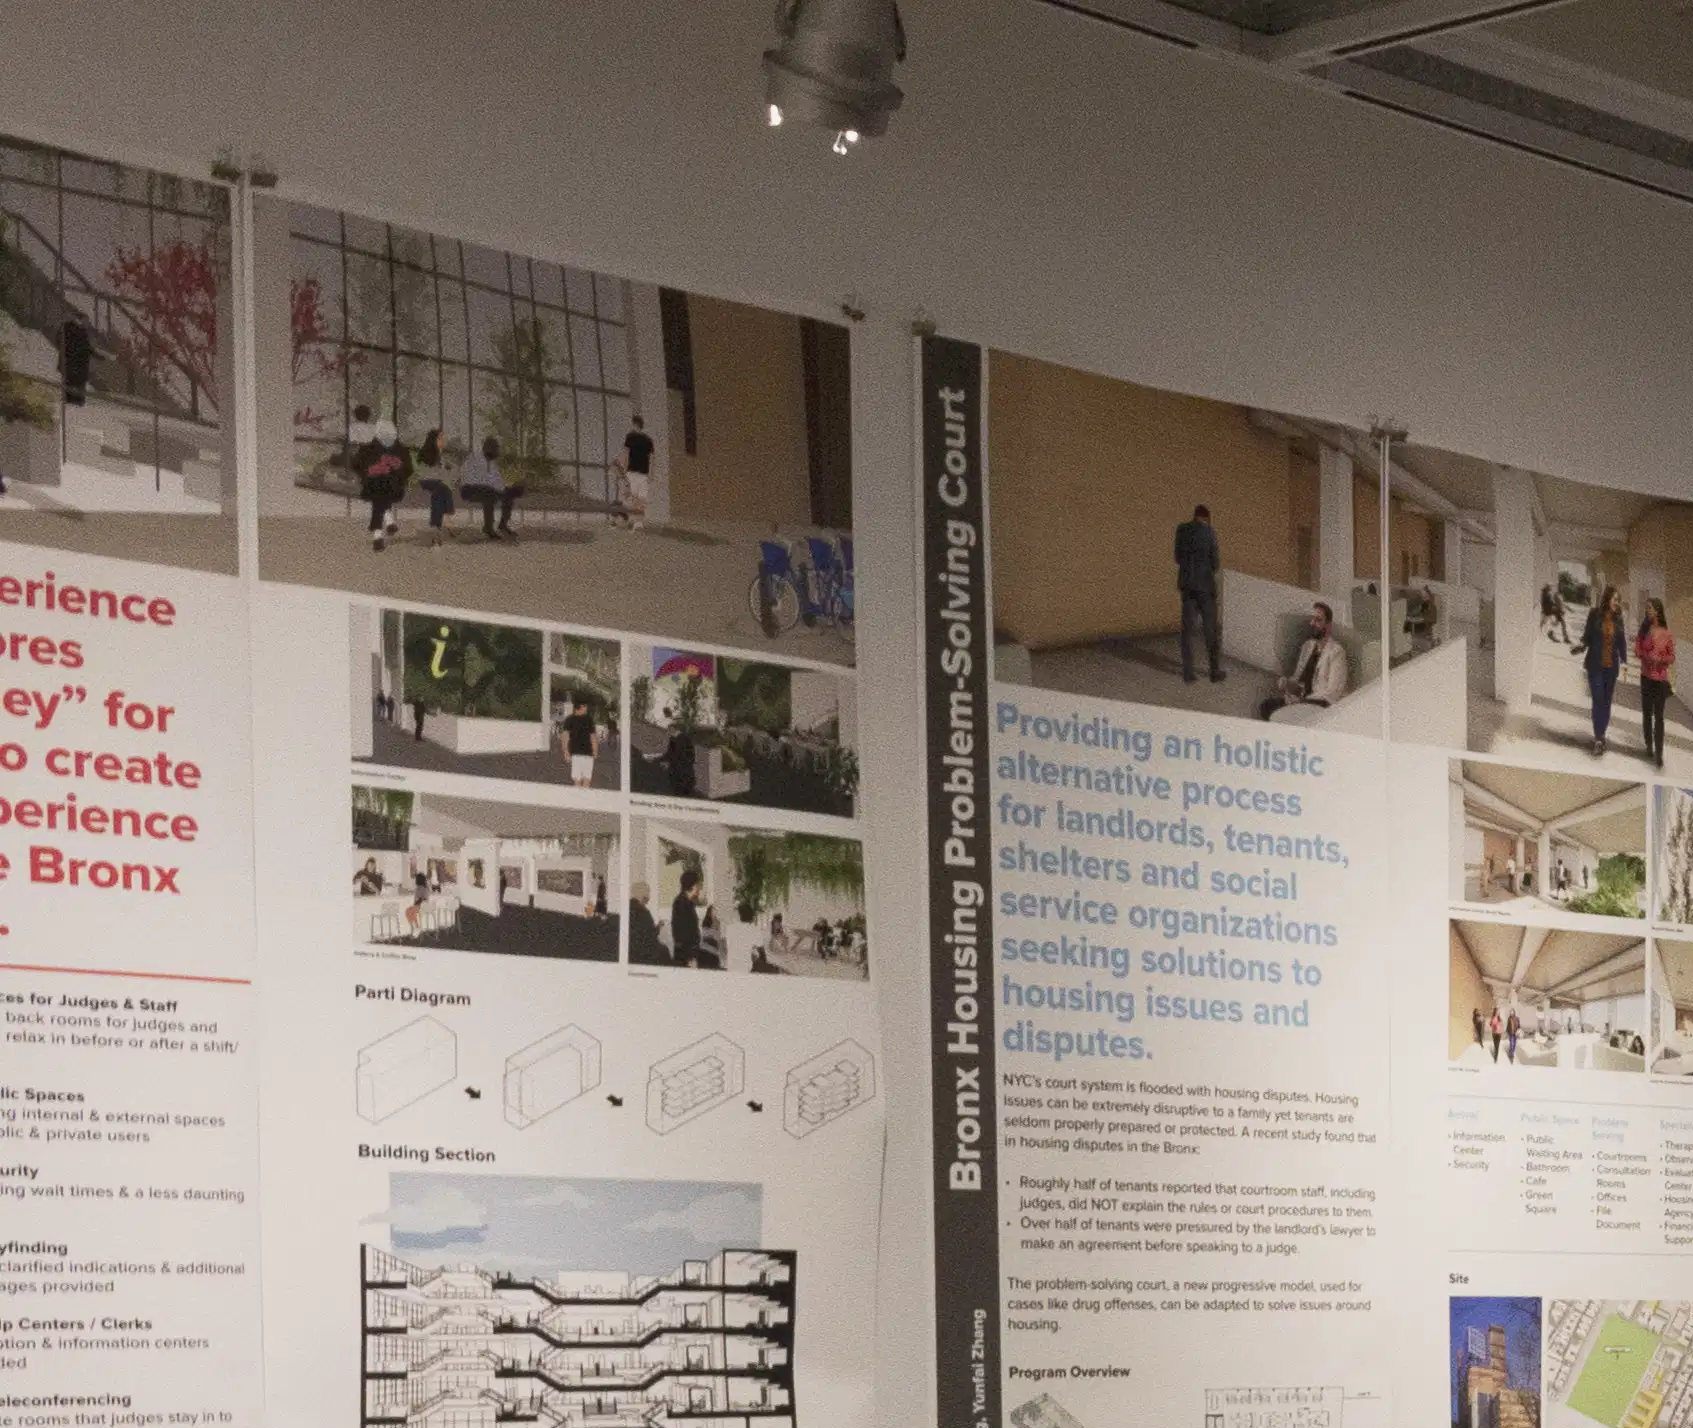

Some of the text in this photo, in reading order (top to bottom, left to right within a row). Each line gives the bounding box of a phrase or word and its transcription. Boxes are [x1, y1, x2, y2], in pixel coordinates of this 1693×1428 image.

[0, 571, 176, 626] erience
[0, 632, 84, 668] res
[104, 688, 176, 733] for
[995, 700, 1323, 776] Providing an holistic
[45, 747, 202, 789] create
[937, 386, 984, 1190] Bronx Housing Problem-Solving Court
[996, 751, 1302, 816] alternative process
[996, 792, 1348, 868] for landlords, tenants,
[29, 845, 181, 894] Bronx
[998, 839, 1296, 900] shelters and social
[999, 890, 1337, 946] service organizations
[1000, 935, 1322, 986] seeking solutions to
[0, 992, 24, 1004] es
[354, 983, 471, 1007] Parti Diagram
[1001, 973, 1308, 1027] housing issues and
[1002, 1019, 1152, 1062] disputes.
[357, 1143, 496, 1163] Building Section
[1448, 1272, 1469, 1284] Site
[1008, 1364, 1130, 1382] Program Overview
